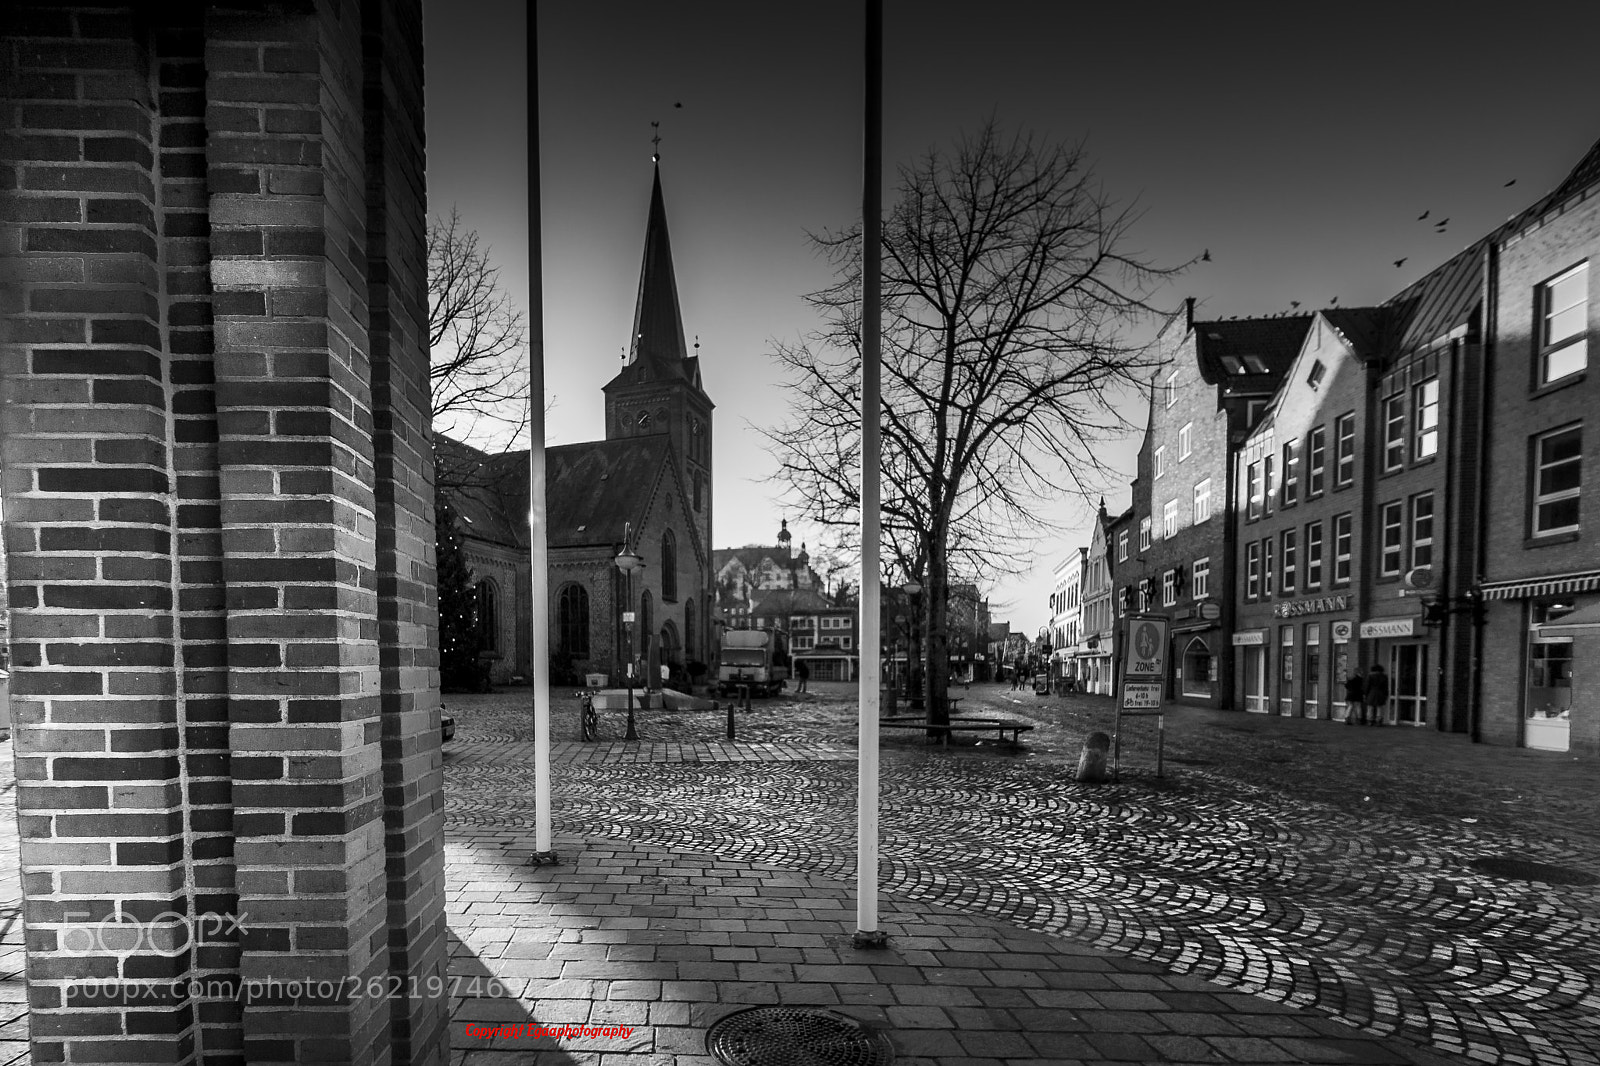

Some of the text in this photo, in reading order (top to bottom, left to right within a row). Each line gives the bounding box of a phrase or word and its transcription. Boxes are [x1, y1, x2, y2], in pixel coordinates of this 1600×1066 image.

[1273, 595, 1347, 618] ROSSMANN
[1361, 623, 1412, 637] ROSSMANN
[1134, 661, 1155, 672] ZONE
